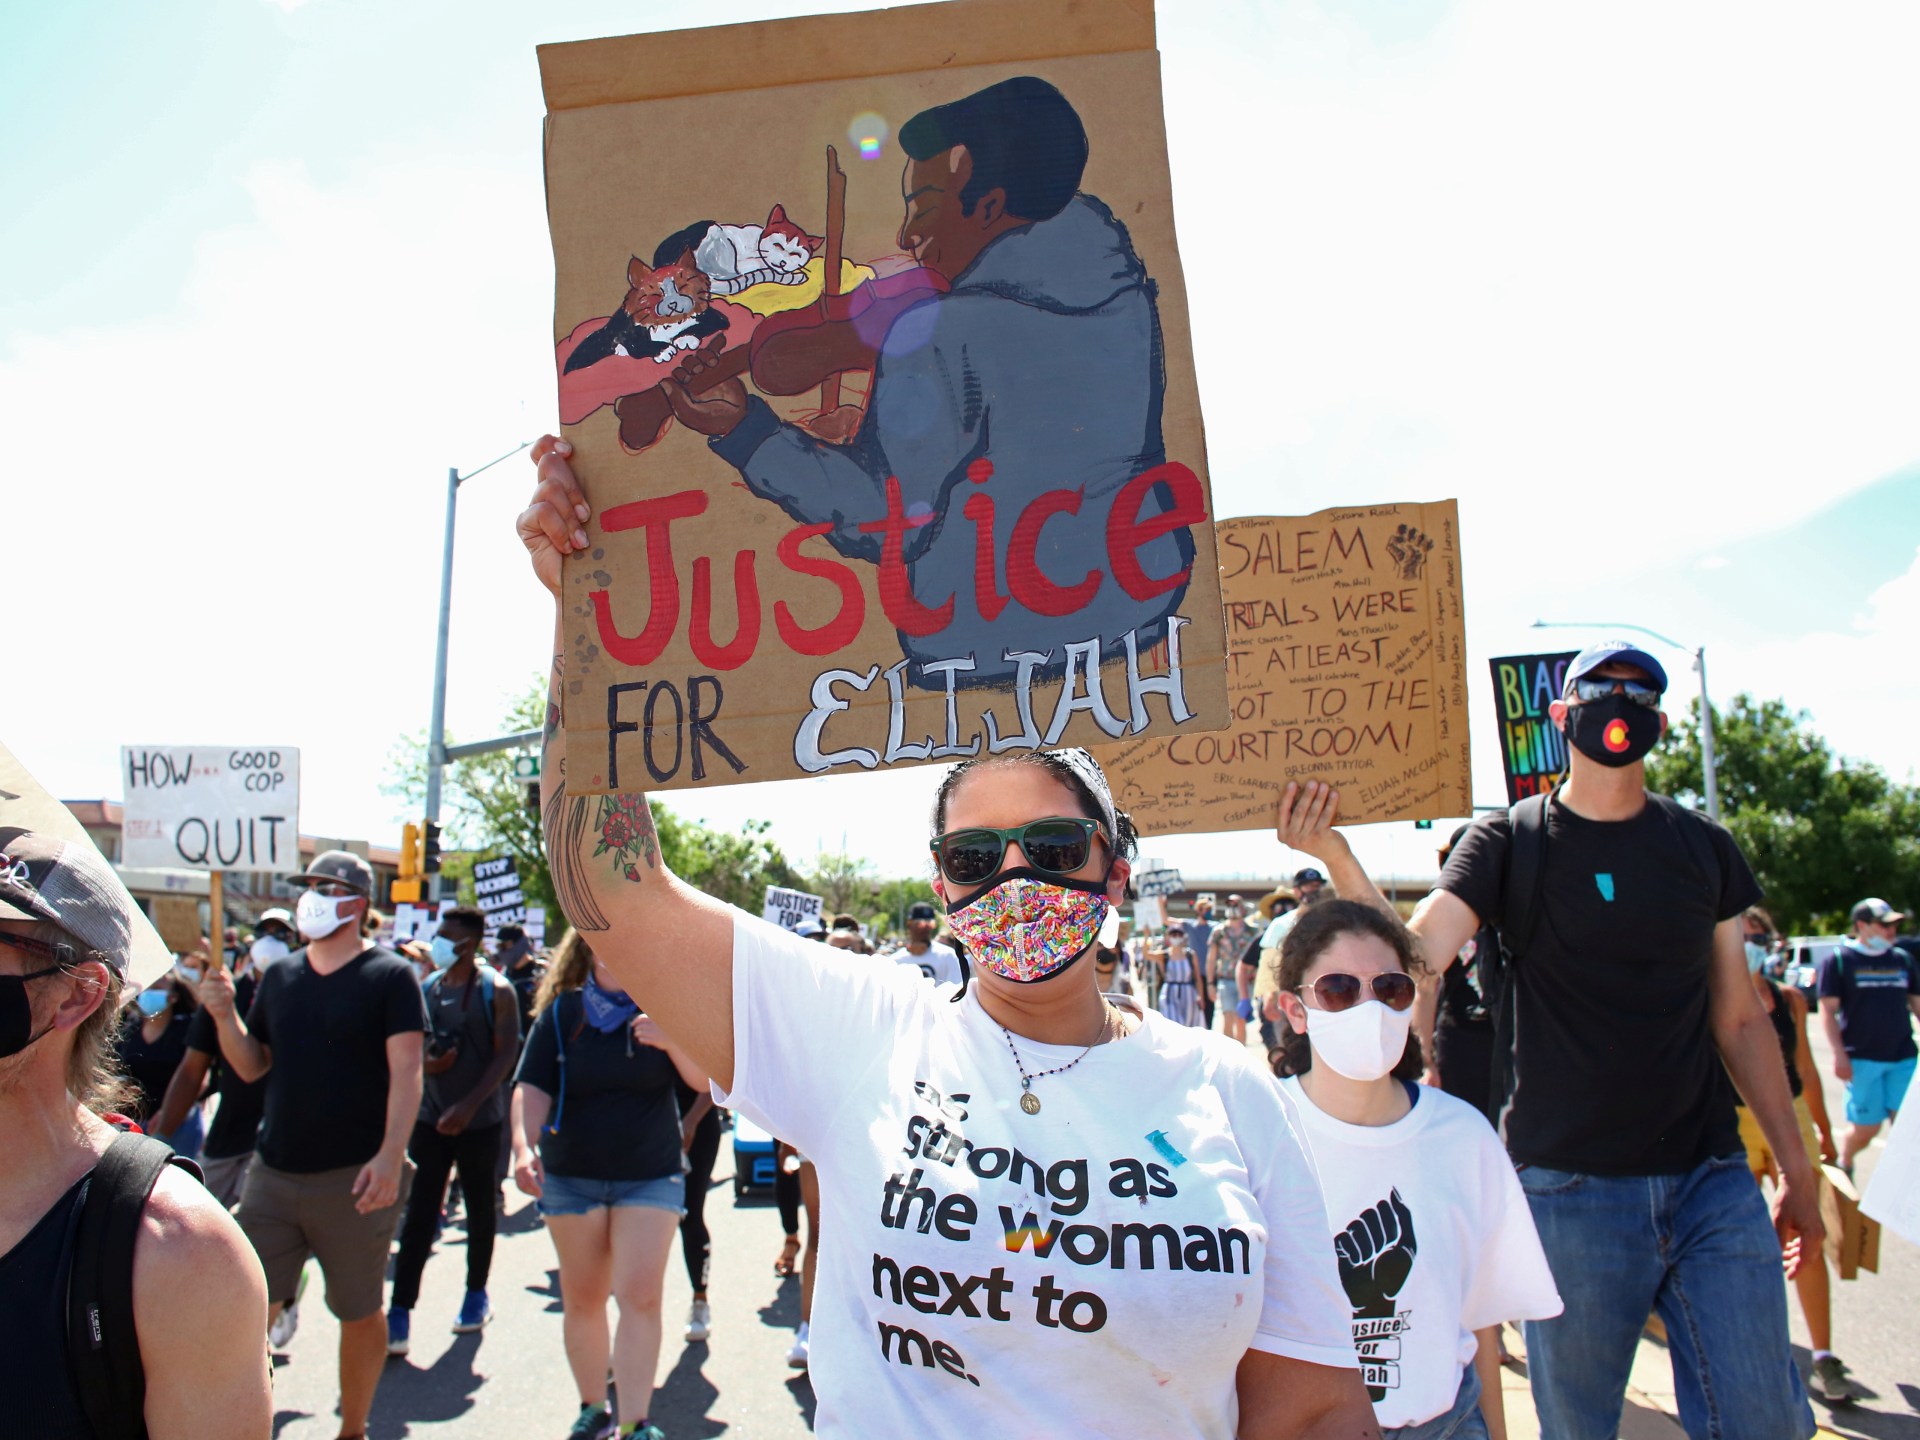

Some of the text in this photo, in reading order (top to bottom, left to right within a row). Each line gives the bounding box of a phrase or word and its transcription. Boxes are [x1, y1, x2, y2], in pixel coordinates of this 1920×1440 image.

[588, 457, 1208, 671] Justice
[1222, 525, 1374, 579] SALEM
[1332, 588, 1418, 622] WERE
[606, 614, 1198, 790] FOR ELIJAH
[1302, 686, 1347, 717] TO
[1361, 679, 1430, 711] THE
[1499, 659, 1568, 720] BLAC
[128, 749, 193, 790] HOW
[228, 750, 281, 771] GOOD
[245, 771, 285, 793] COP
[175, 815, 286, 867] QUIT
[474, 857, 509, 879] STOP
[768, 891, 819, 916] JUSTICE
[914, 1080, 971, 1122] as
[902, 1114, 1178, 1217] strong as
[880, 1167, 1251, 1275] the woman
[872, 1252, 1108, 1334] next to
[877, 1320, 981, 1387] me.
[1352, 1318, 1401, 1338] ustice
